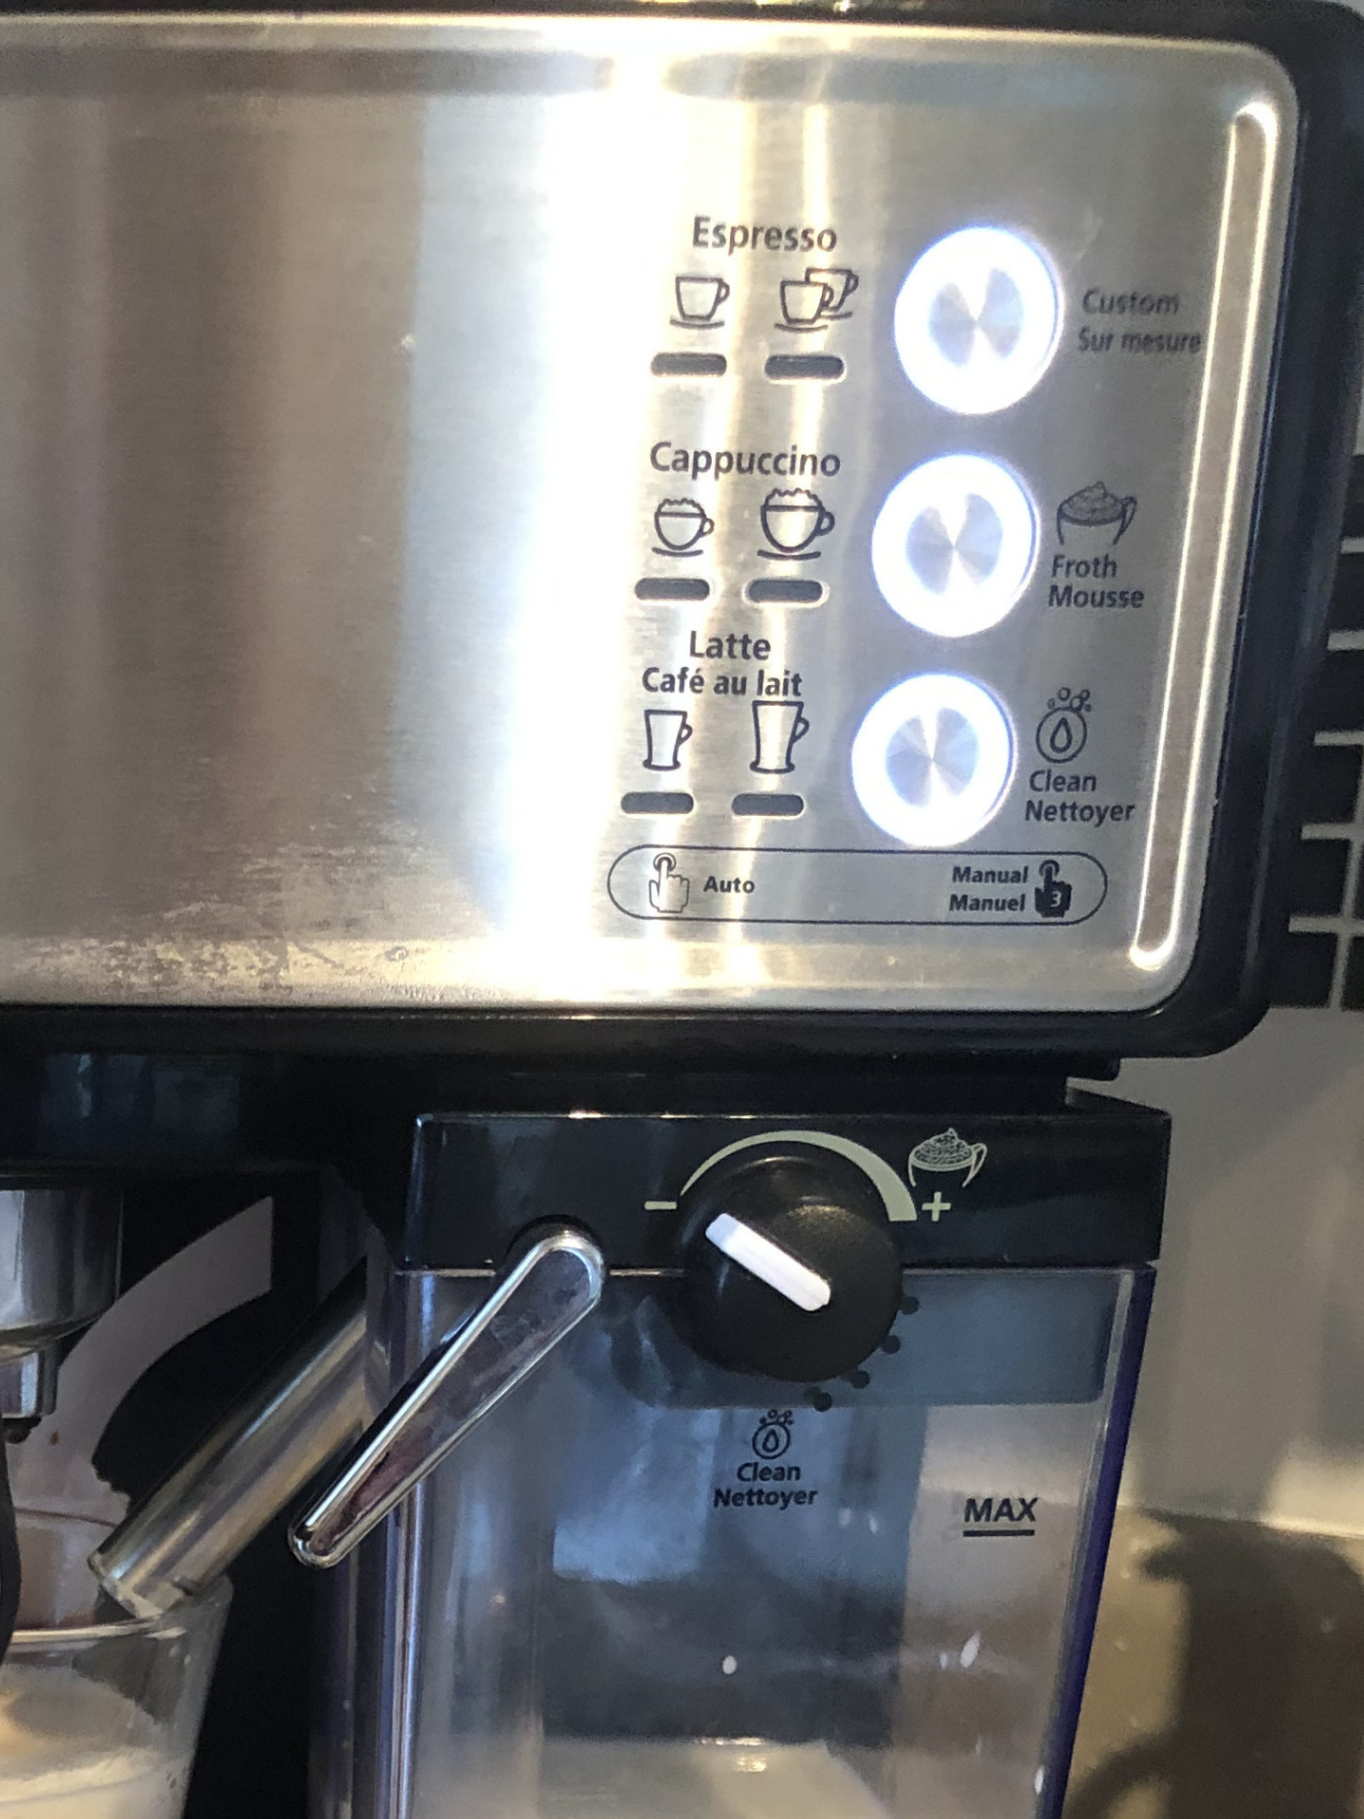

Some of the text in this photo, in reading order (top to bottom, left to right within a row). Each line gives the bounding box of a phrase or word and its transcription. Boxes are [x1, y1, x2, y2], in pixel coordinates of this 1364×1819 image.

[692, 214, 838, 255] Espresso
[1082, 286, 1179, 316] Custom
[1078, 325, 1202, 354] Sur mesure
[649, 441, 841, 480] Cappuccino
[1051, 554, 1118, 580] Froth
[1048, 585, 1145, 610] Mousse
[689, 630, 772, 661] Latte
[641, 666, 804, 698] Café au lait
[1029, 769, 1098, 794] Clean
[1024, 799, 1136, 826] Nettoyer
[703, 875, 756, 895] Auto
[952, 865, 1029, 884] Manual
[948, 893, 1026, 912] Manuel
[1049, 890, 1063, 908] 3
[736, 1462, 801, 1483] Clean
[713, 1486, 818, 1511] Nettoyer
[964, 1498, 1038, 1523] MAX
